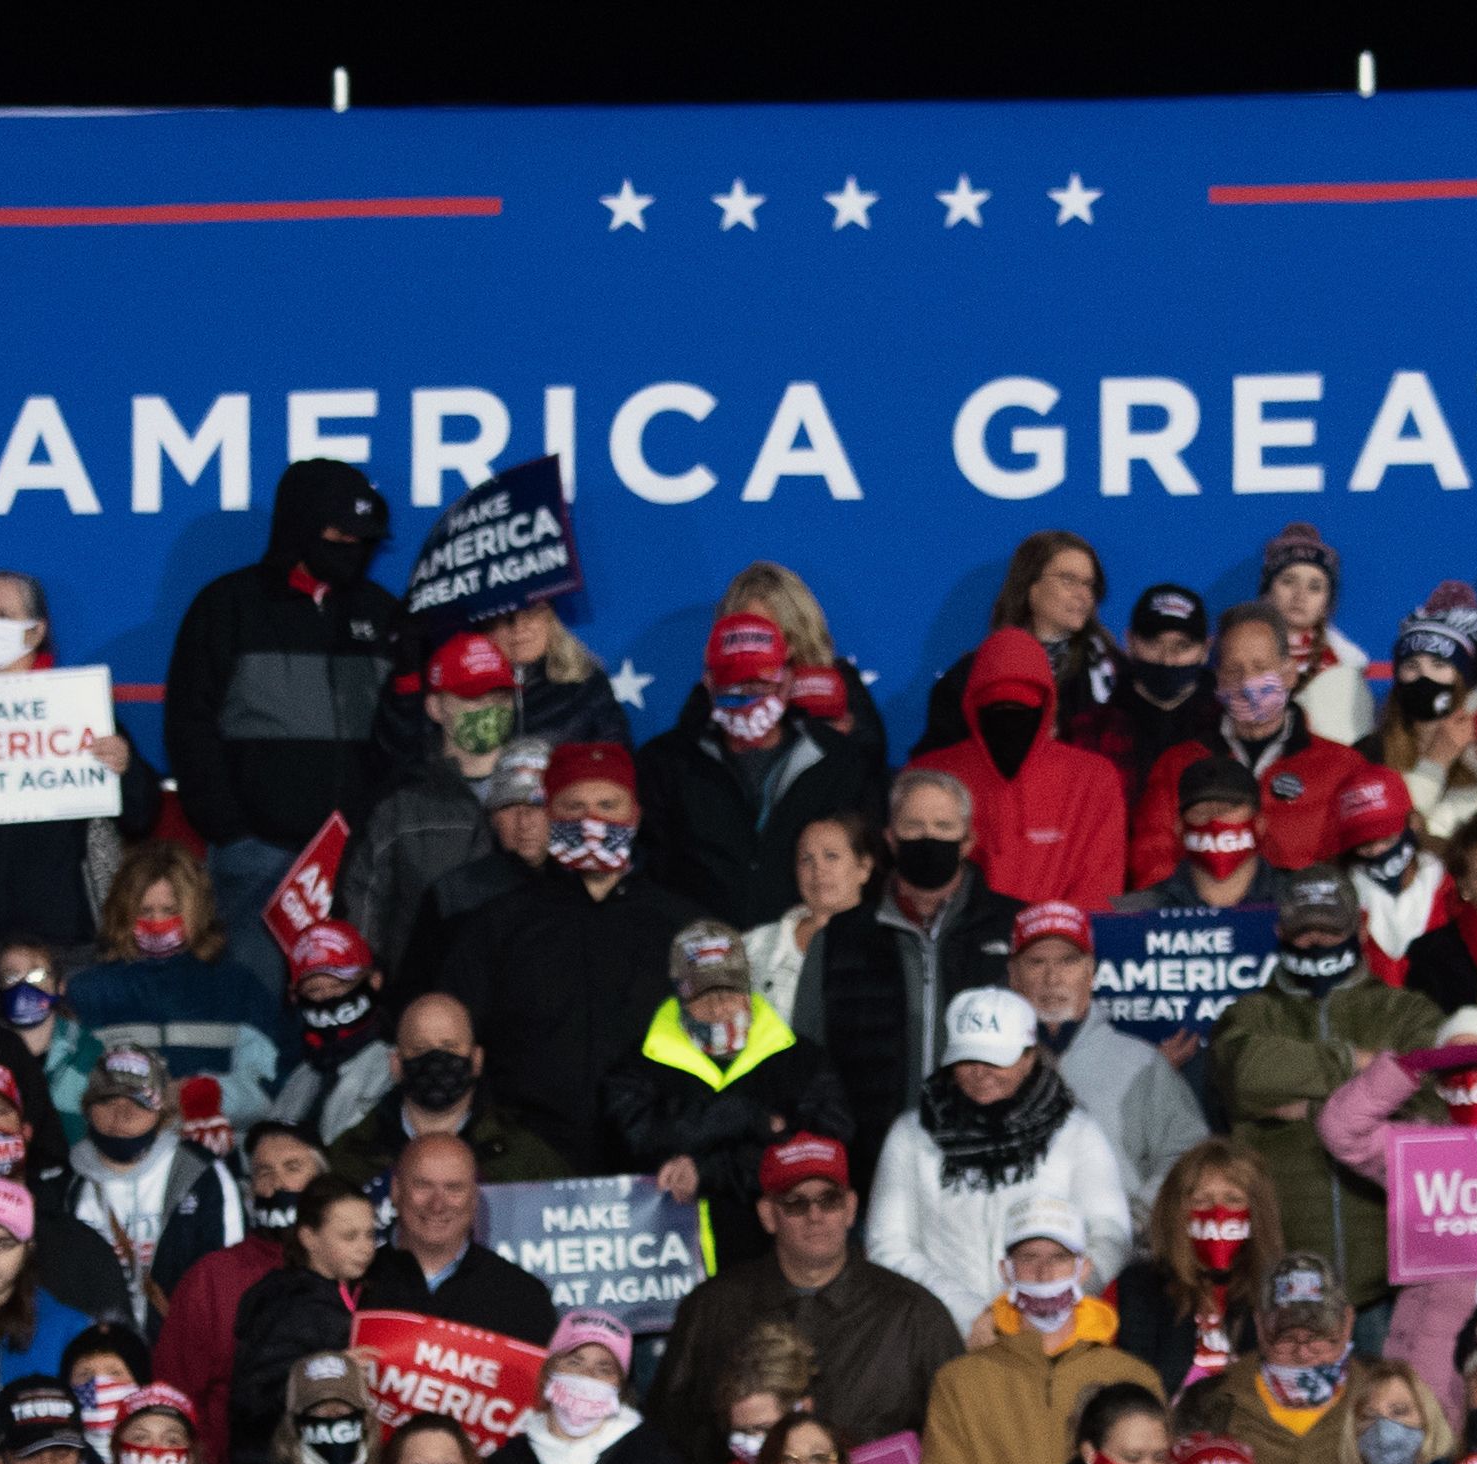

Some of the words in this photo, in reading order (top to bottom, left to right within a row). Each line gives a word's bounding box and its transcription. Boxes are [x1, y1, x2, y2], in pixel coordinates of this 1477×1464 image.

[447, 491, 512, 534] MAKE
[413, 505, 563, 584] AMERICA
[410, 568, 484, 613] GREAT
[488, 543, 570, 584] AGAIN
[20, 767, 107, 789] AGAIN
[1146, 928, 1233, 953] MAKE
[542, 1202, 628, 1233] MAKE
[497, 1234, 689, 1277] AMERICA
[598, 1275, 694, 1301] AGAIN
[415, 1342, 500, 1385] MAKE
[12, 1400, 73, 1422] TRUMP
[366, 1362, 533, 1437] AMERICA
